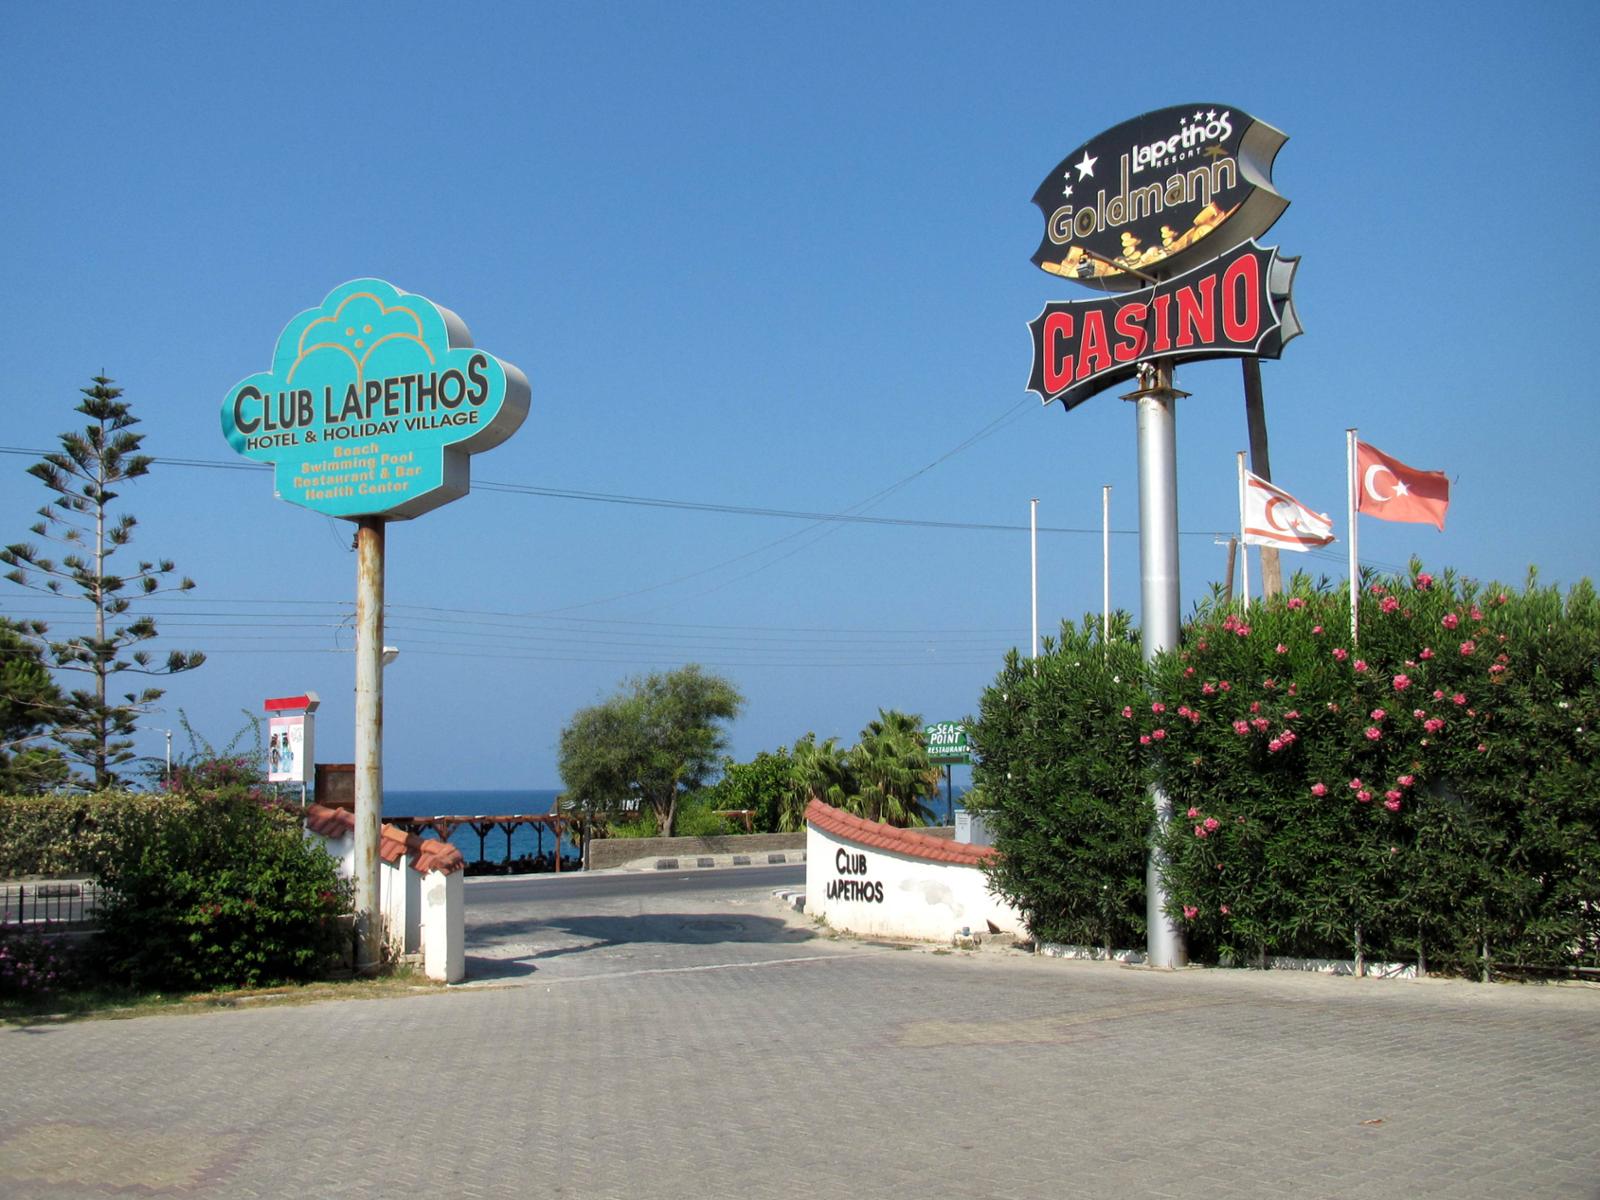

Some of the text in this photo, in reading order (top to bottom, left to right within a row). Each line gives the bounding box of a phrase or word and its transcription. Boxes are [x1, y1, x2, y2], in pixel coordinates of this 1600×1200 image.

[1132, 110, 1233, 174] Lapethos
[1156, 147, 1201, 169] RESORT
[1048, 153, 1237, 245] Goldmann
[1043, 253, 1260, 394] CASINO
[233, 354, 489, 435] CLUB LAPETHOS
[246, 410, 479, 451] HOTEL & HOLIDAY VILLAGE
[301, 451, 415, 474] Swimming Pool
[333, 442, 380, 458] Beach
[293, 464, 423, 489] Restaurant & Bar
[305, 481, 410, 501] Health Center
[930, 731, 961, 745] POINT
[936, 723, 955, 735] SEA
[927, 745, 967, 754] RESTAURANT
[836, 847, 868, 876] CLUB
[826, 879, 884, 904] LAPETHOS
